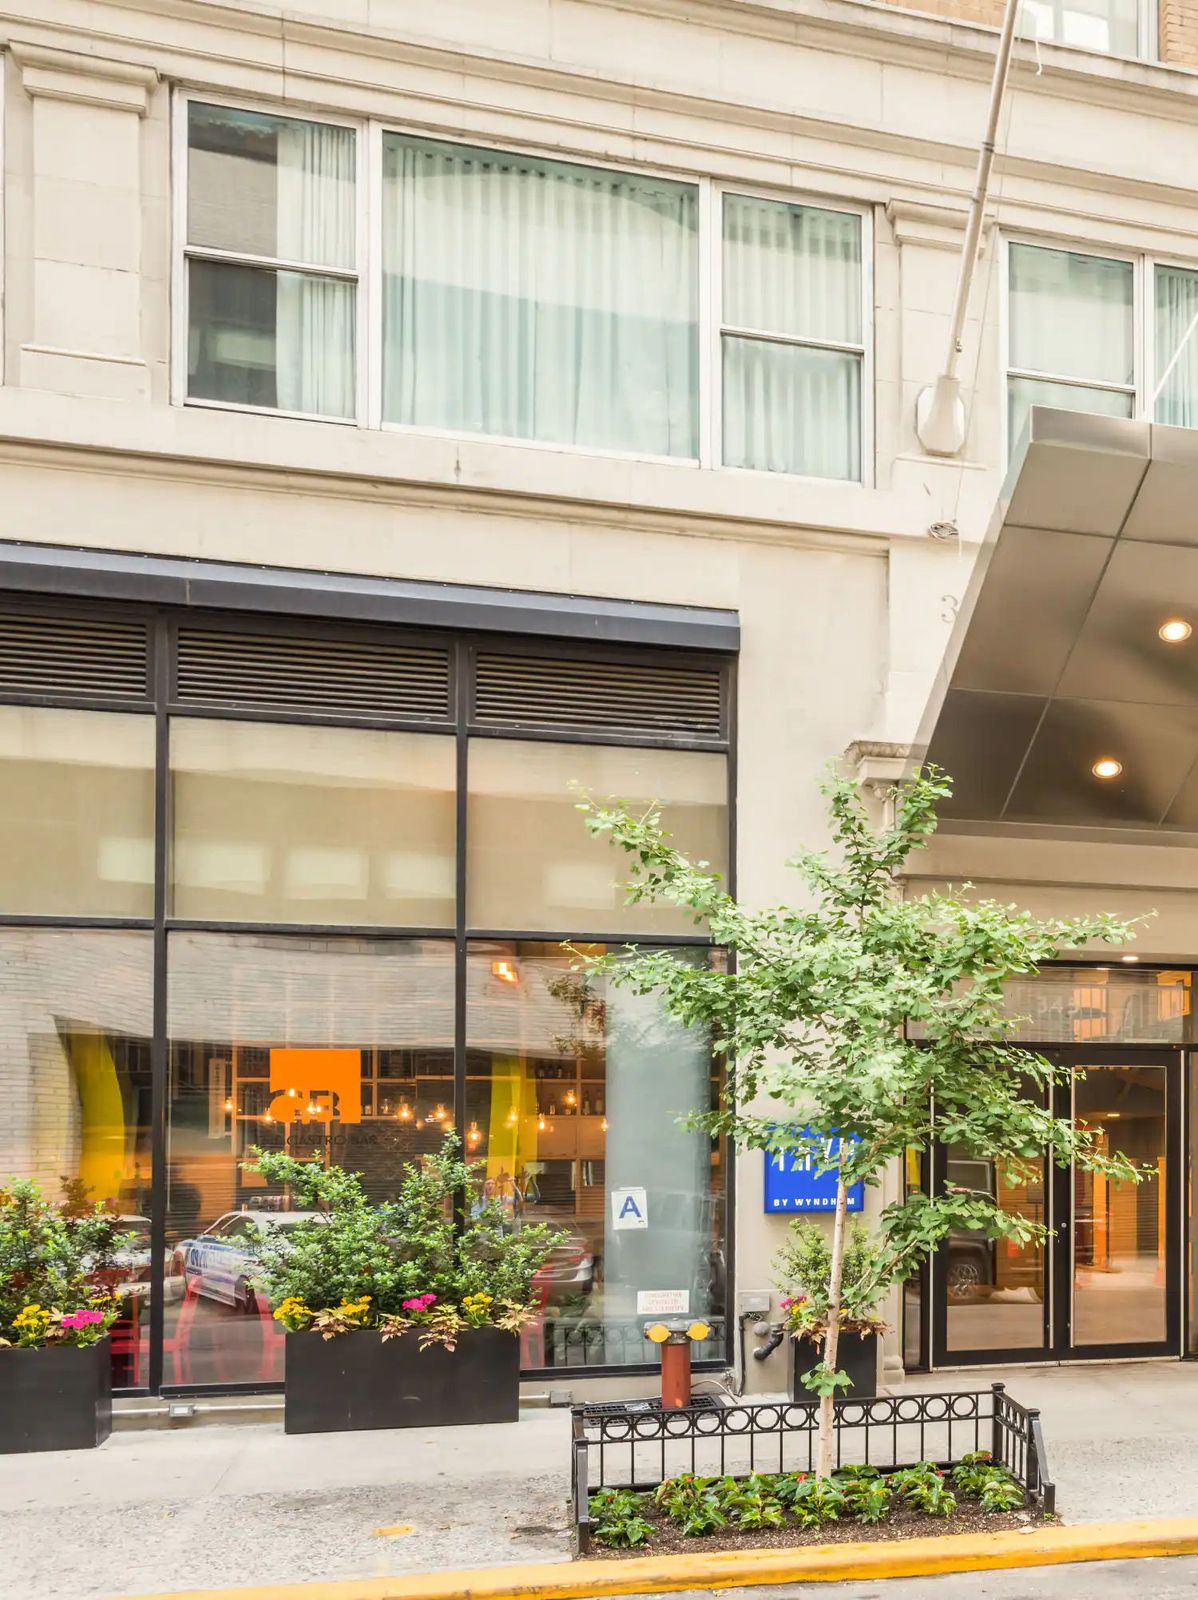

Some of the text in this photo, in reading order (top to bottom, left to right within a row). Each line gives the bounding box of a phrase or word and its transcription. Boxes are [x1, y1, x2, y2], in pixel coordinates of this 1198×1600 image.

[618, 1194, 642, 1219] A
[773, 1198, 856, 1207] BY WYNDHM
